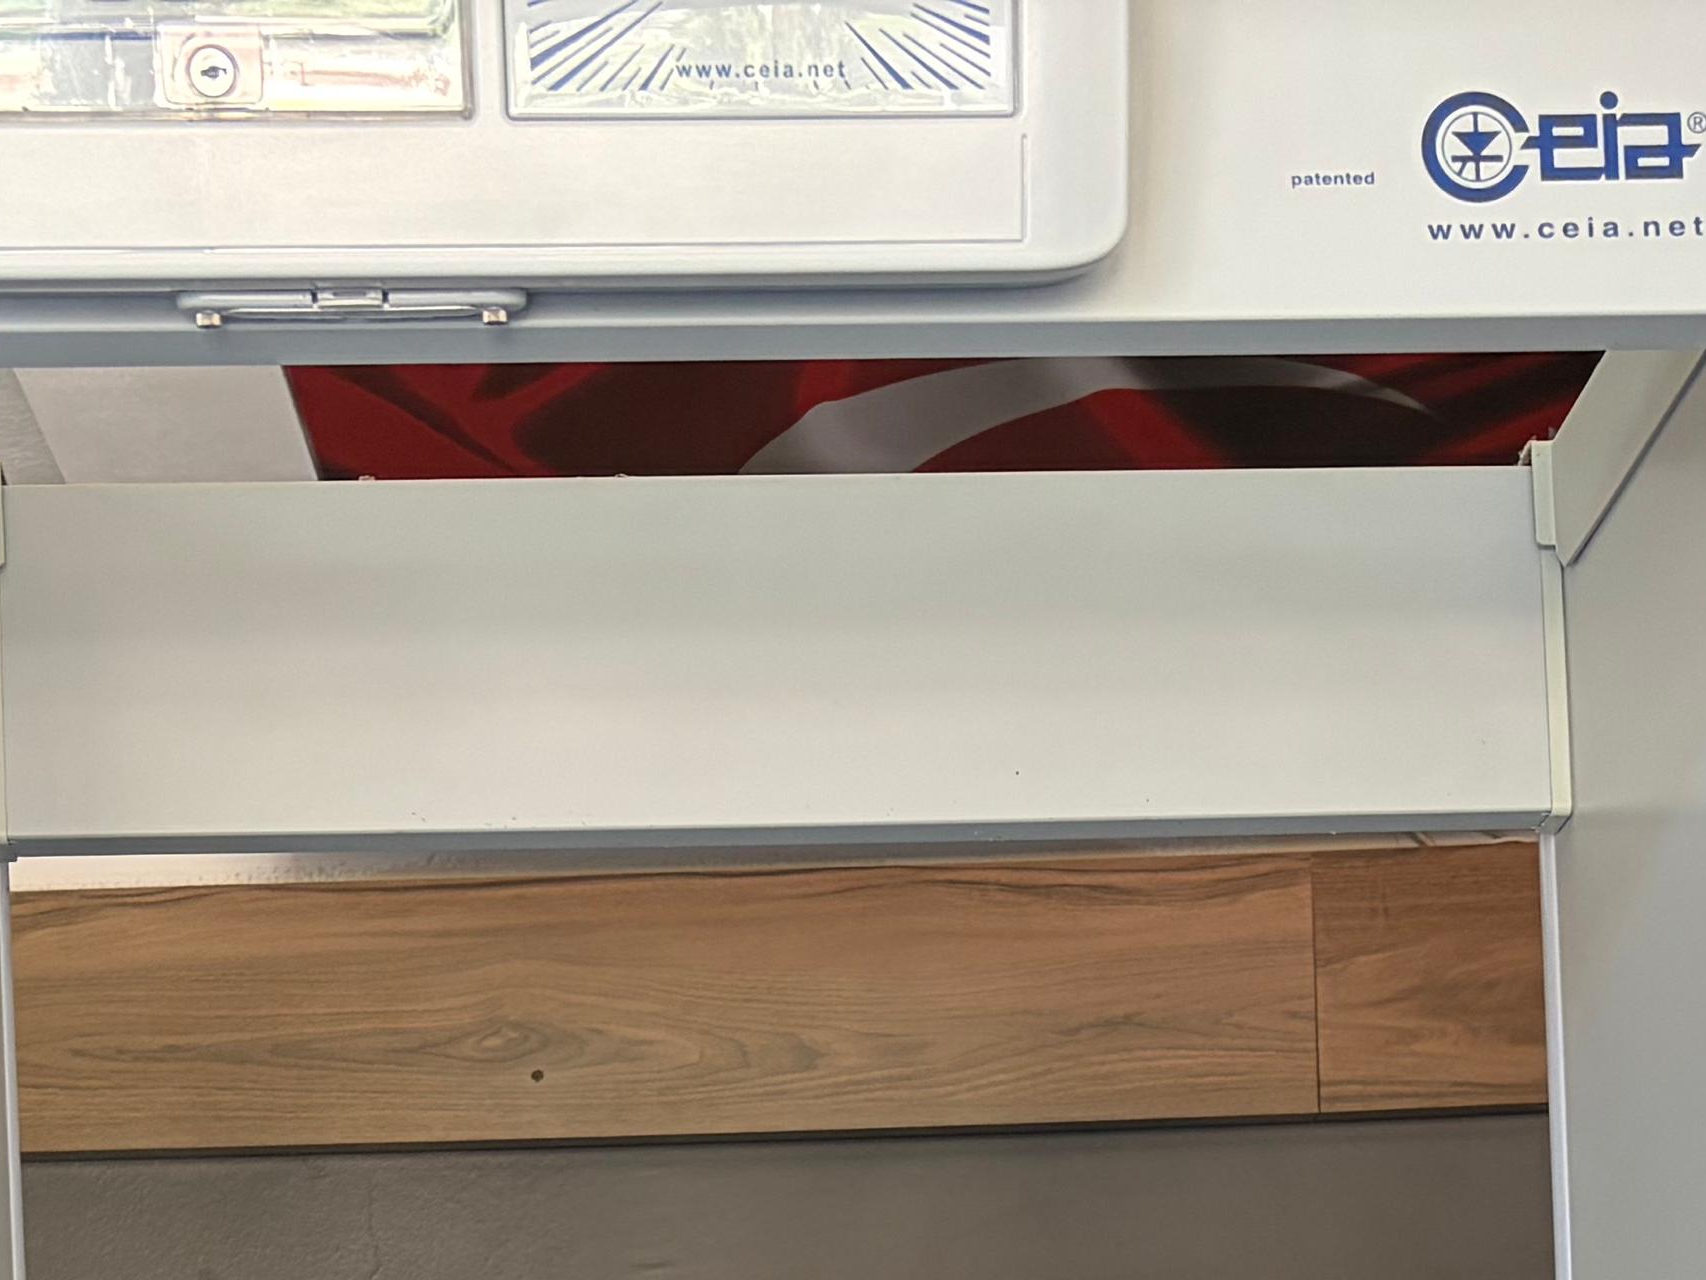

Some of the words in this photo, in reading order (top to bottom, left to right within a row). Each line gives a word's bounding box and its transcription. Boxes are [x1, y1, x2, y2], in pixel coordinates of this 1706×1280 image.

[675, 59, 846, 79] www.ceia.net
[1291, 171, 1376, 188] patented
[1427, 216, 1705, 241] www.ceia.net
